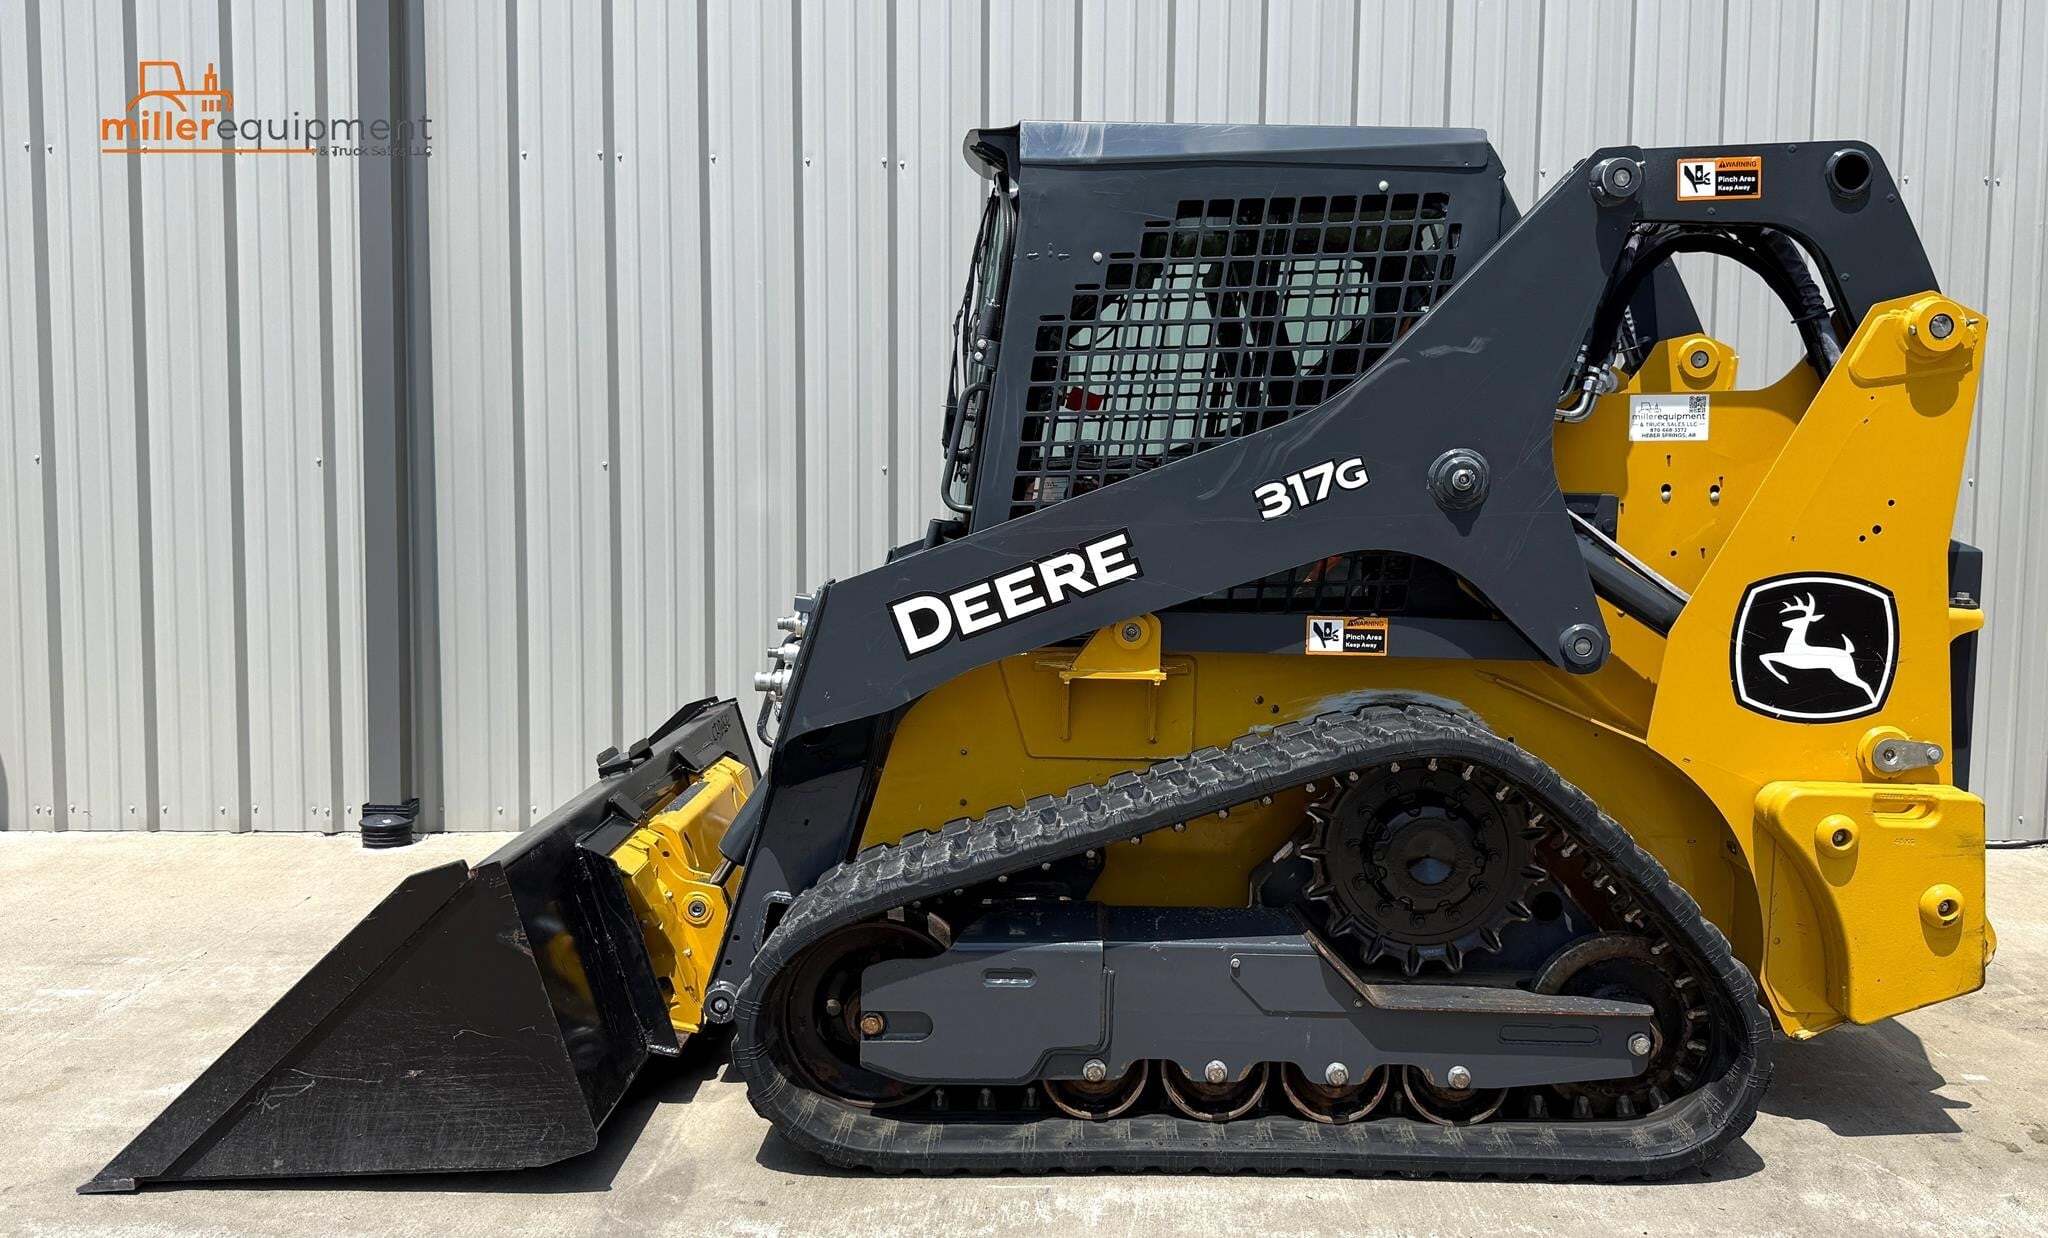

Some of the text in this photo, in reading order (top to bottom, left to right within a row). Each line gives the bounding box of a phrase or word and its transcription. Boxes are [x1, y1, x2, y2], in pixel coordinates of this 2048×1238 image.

[1725, 160, 1757, 168] WARNING
[1717, 175, 1738, 183] Pinch
[1631, 413, 1706, 421] millerequipment
[1255, 457, 1368, 520] 317G
[891, 534, 1138, 655] DEERE
